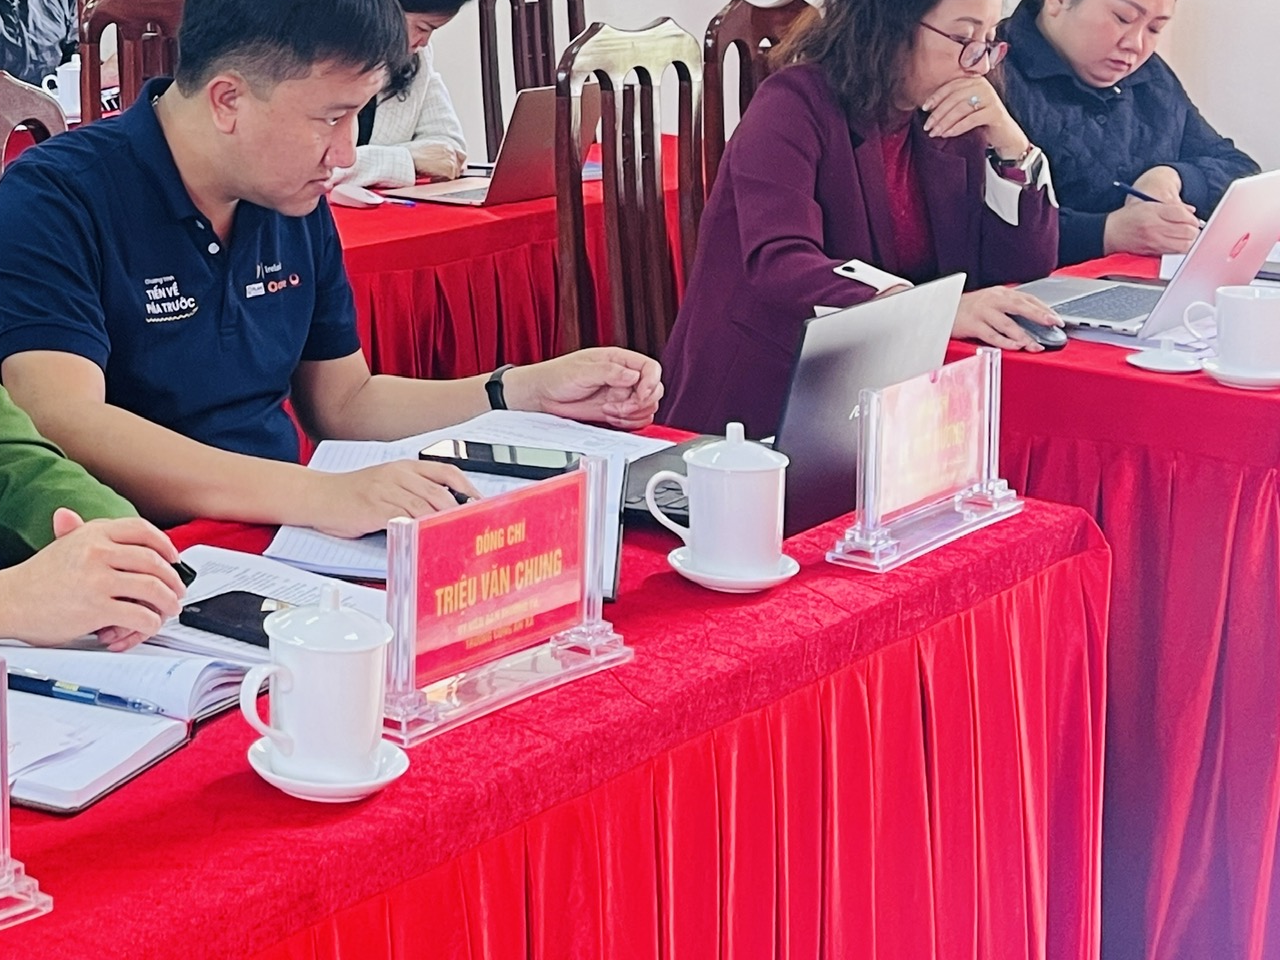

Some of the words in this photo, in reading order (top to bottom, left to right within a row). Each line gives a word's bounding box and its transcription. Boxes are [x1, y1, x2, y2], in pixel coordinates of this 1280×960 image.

[435, 574, 477, 617] TRIỆU
[481, 563, 510, 601] VĂN
[515, 548, 562, 590] CHUNG
